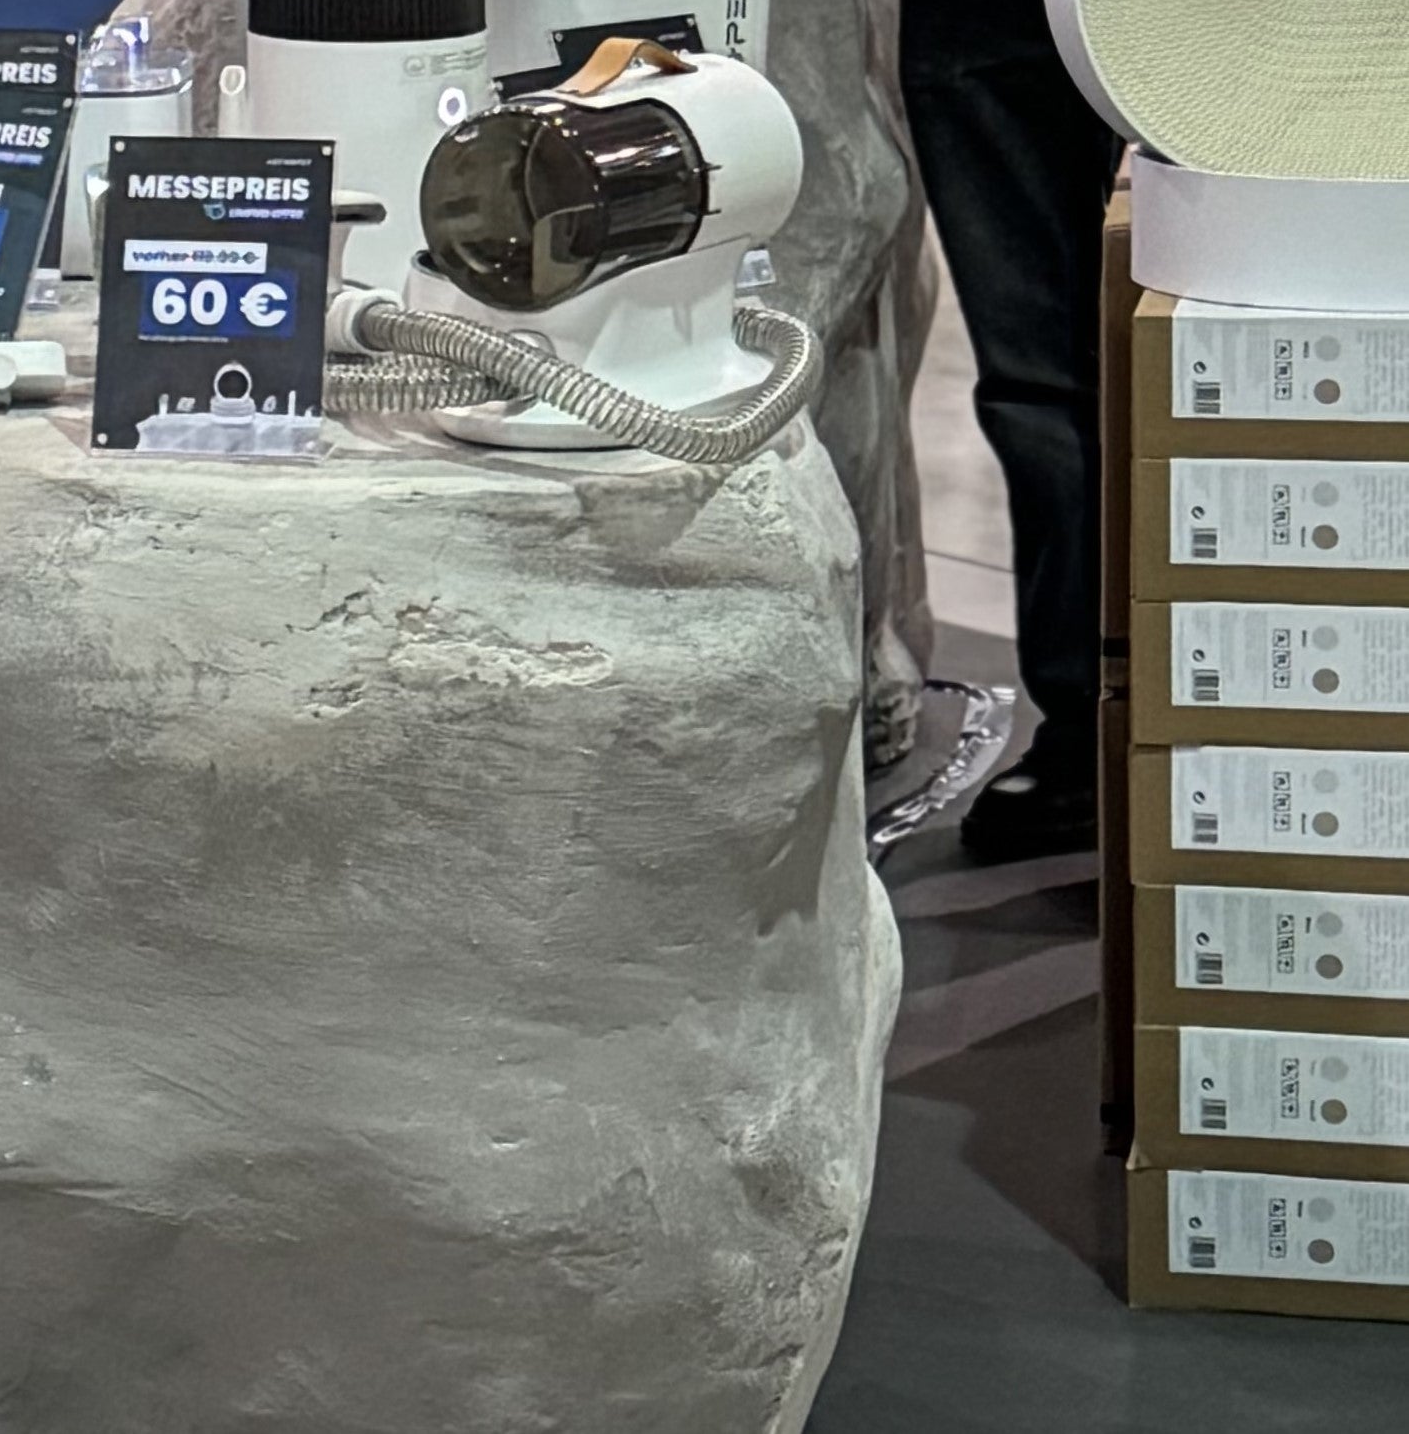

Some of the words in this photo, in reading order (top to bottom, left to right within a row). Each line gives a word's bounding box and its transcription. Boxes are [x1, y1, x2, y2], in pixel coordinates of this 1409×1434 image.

[128, 174, 311, 202] MESSEPREIS
[152, 278, 228, 326] 60
[239, 282, 288, 327] €
